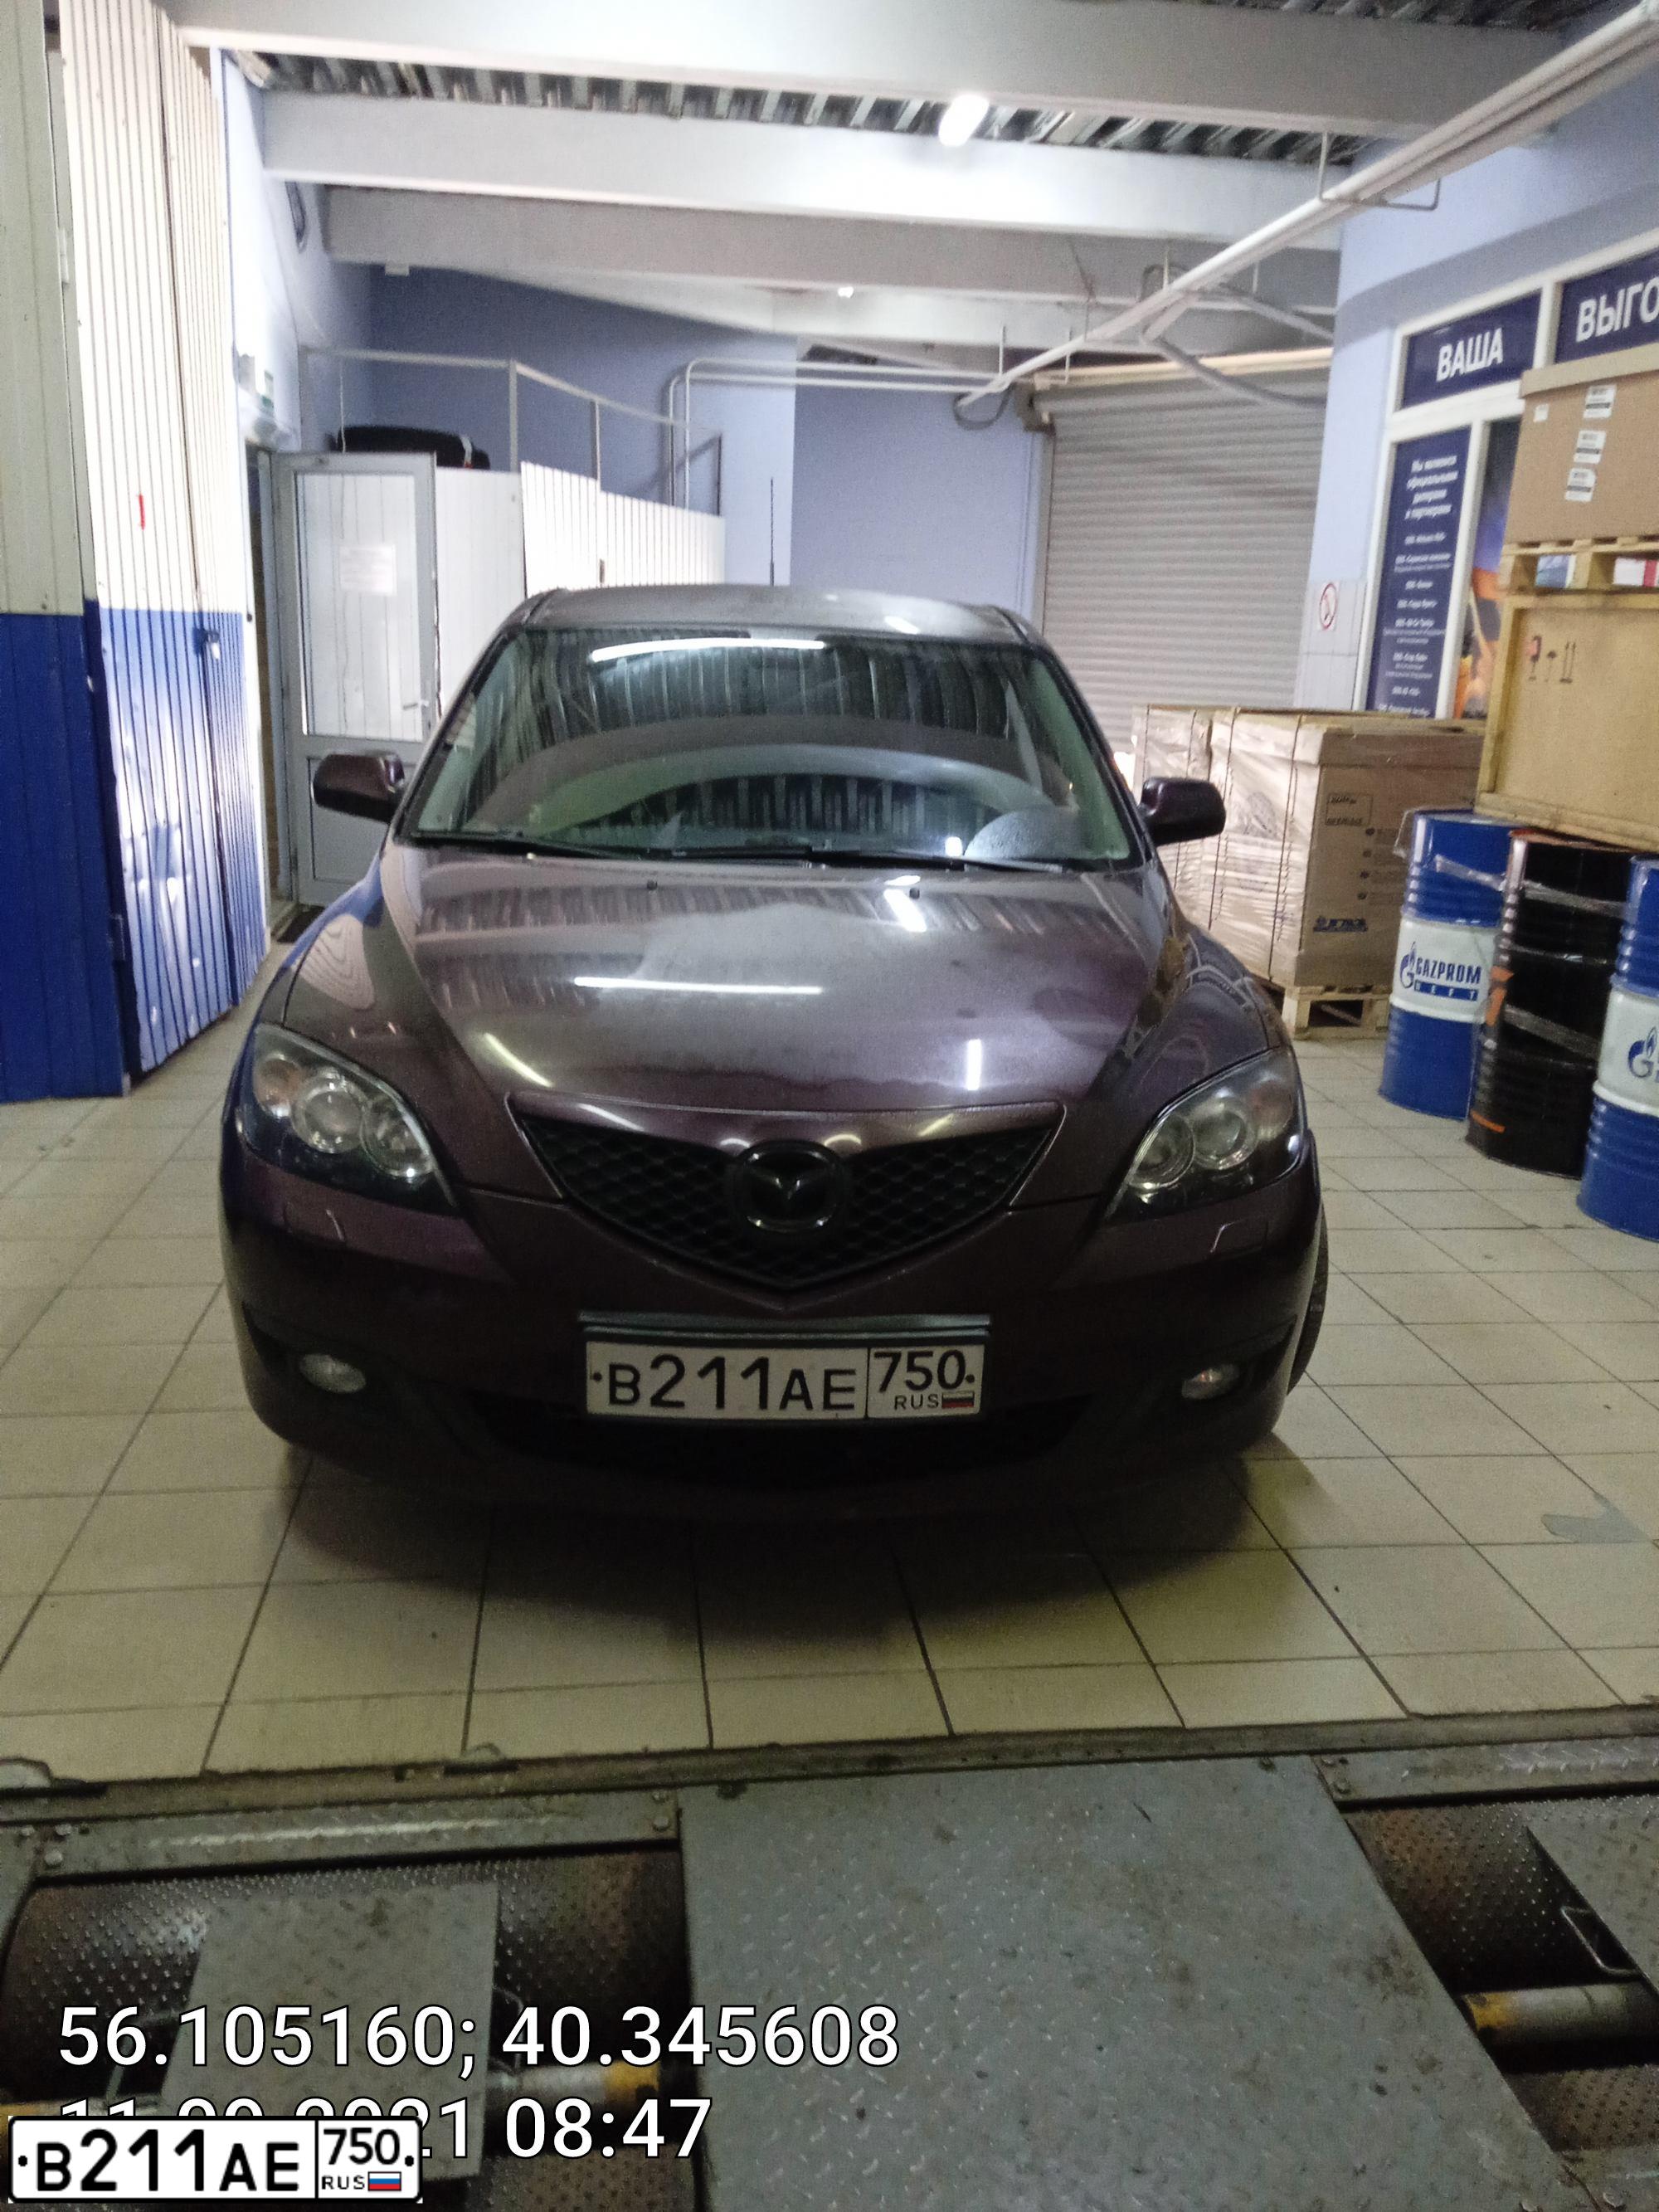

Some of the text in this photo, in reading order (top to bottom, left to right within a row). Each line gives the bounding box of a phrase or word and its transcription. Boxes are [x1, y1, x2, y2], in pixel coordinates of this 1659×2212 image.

[1436, 328, 1503, 382] ВАША
[1415, 957, 1481, 984] GAZPROM
[873, 1349, 966, 1394] 750
[894, 1393, 939, 1411] RUS
